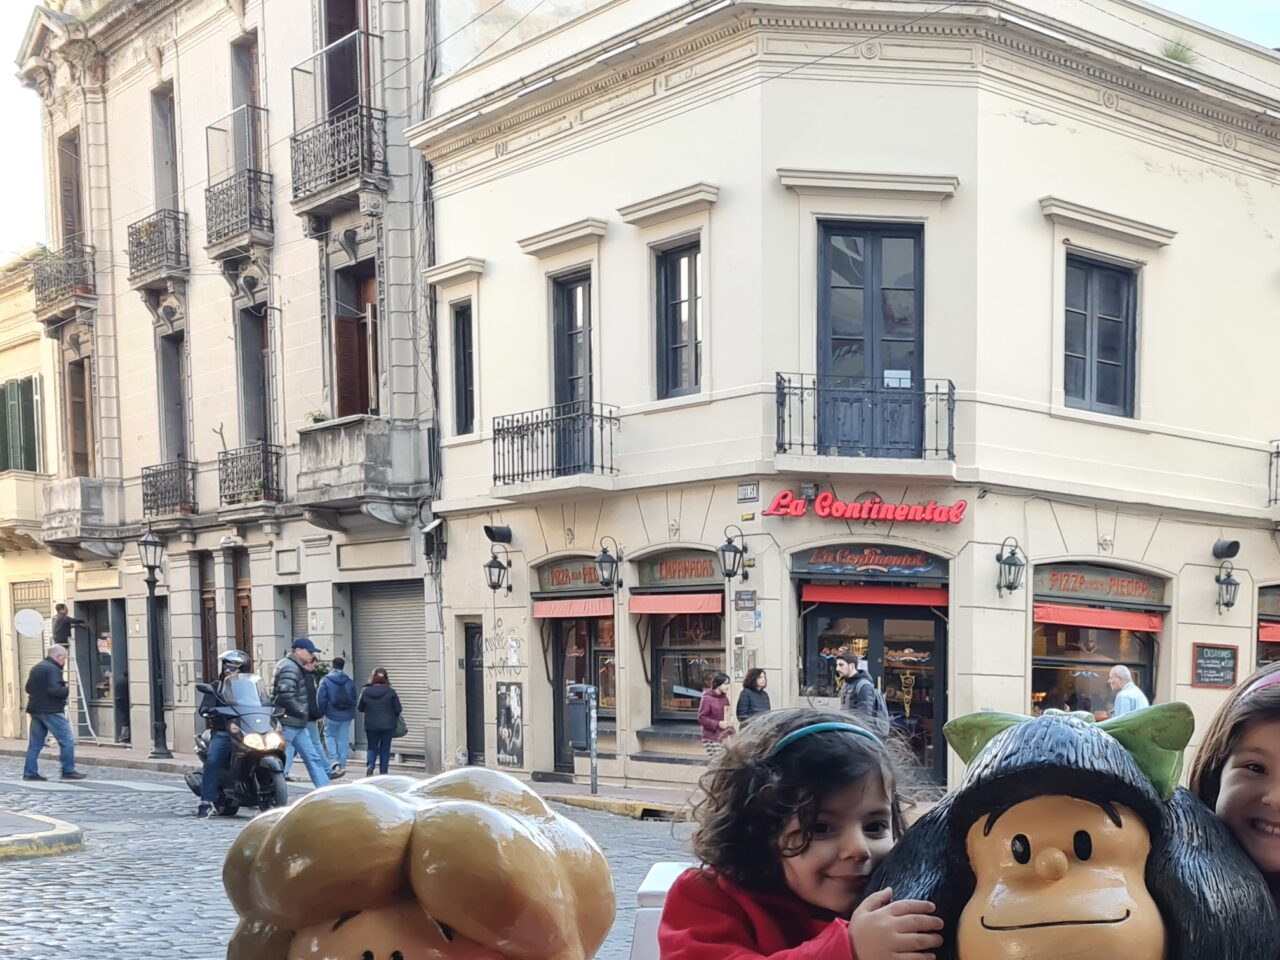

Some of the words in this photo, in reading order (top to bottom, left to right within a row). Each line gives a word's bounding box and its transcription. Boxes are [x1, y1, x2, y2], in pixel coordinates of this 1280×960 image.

[762, 490, 806, 516] La
[814, 491, 967, 524] Continental
[548, 567, 571, 586] PIZZA
[659, 559, 715, 580] EMPANADAS
[1049, 570, 1086, 592] PIZZA
[1106, 576, 1150, 597] PIEDRA
